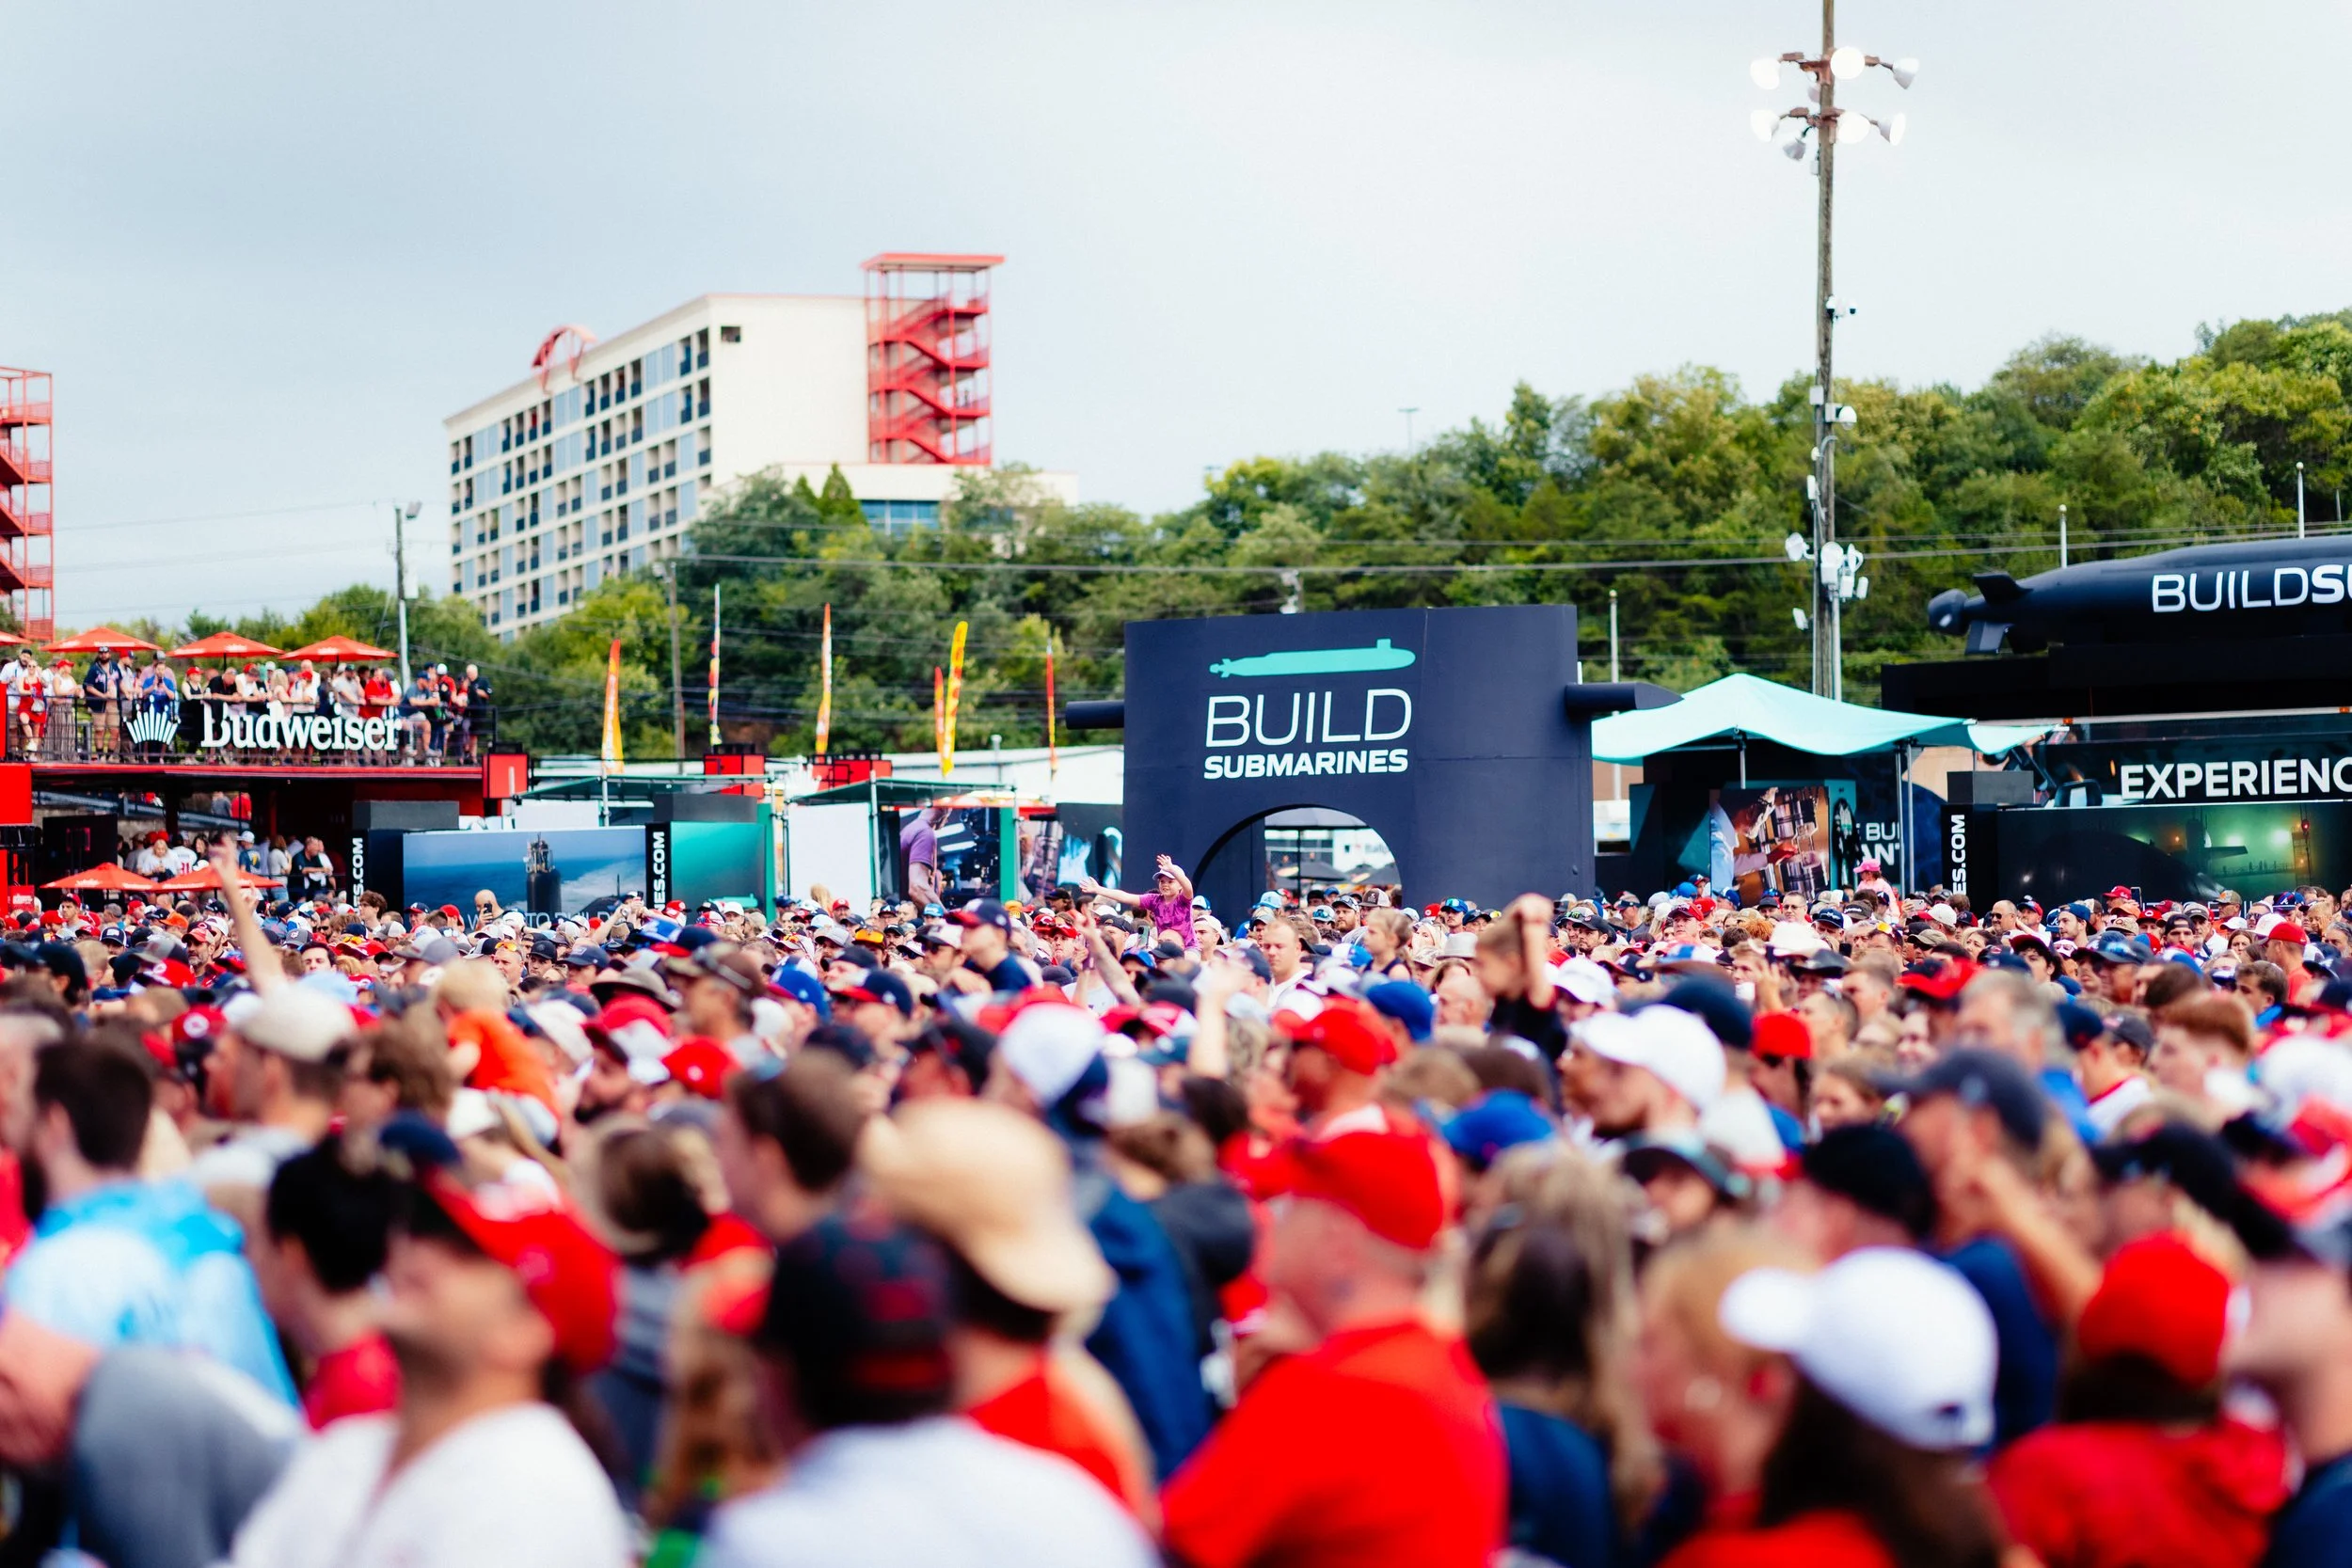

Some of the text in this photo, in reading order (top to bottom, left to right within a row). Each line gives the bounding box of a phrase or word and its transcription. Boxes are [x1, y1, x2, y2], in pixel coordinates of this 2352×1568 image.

[2153, 564, 2352, 612] BUILDS
[200, 700, 403, 751] Budweiser
[1205, 689, 1412, 747] BUILD
[1203, 748, 1408, 780] SUBMARINES
